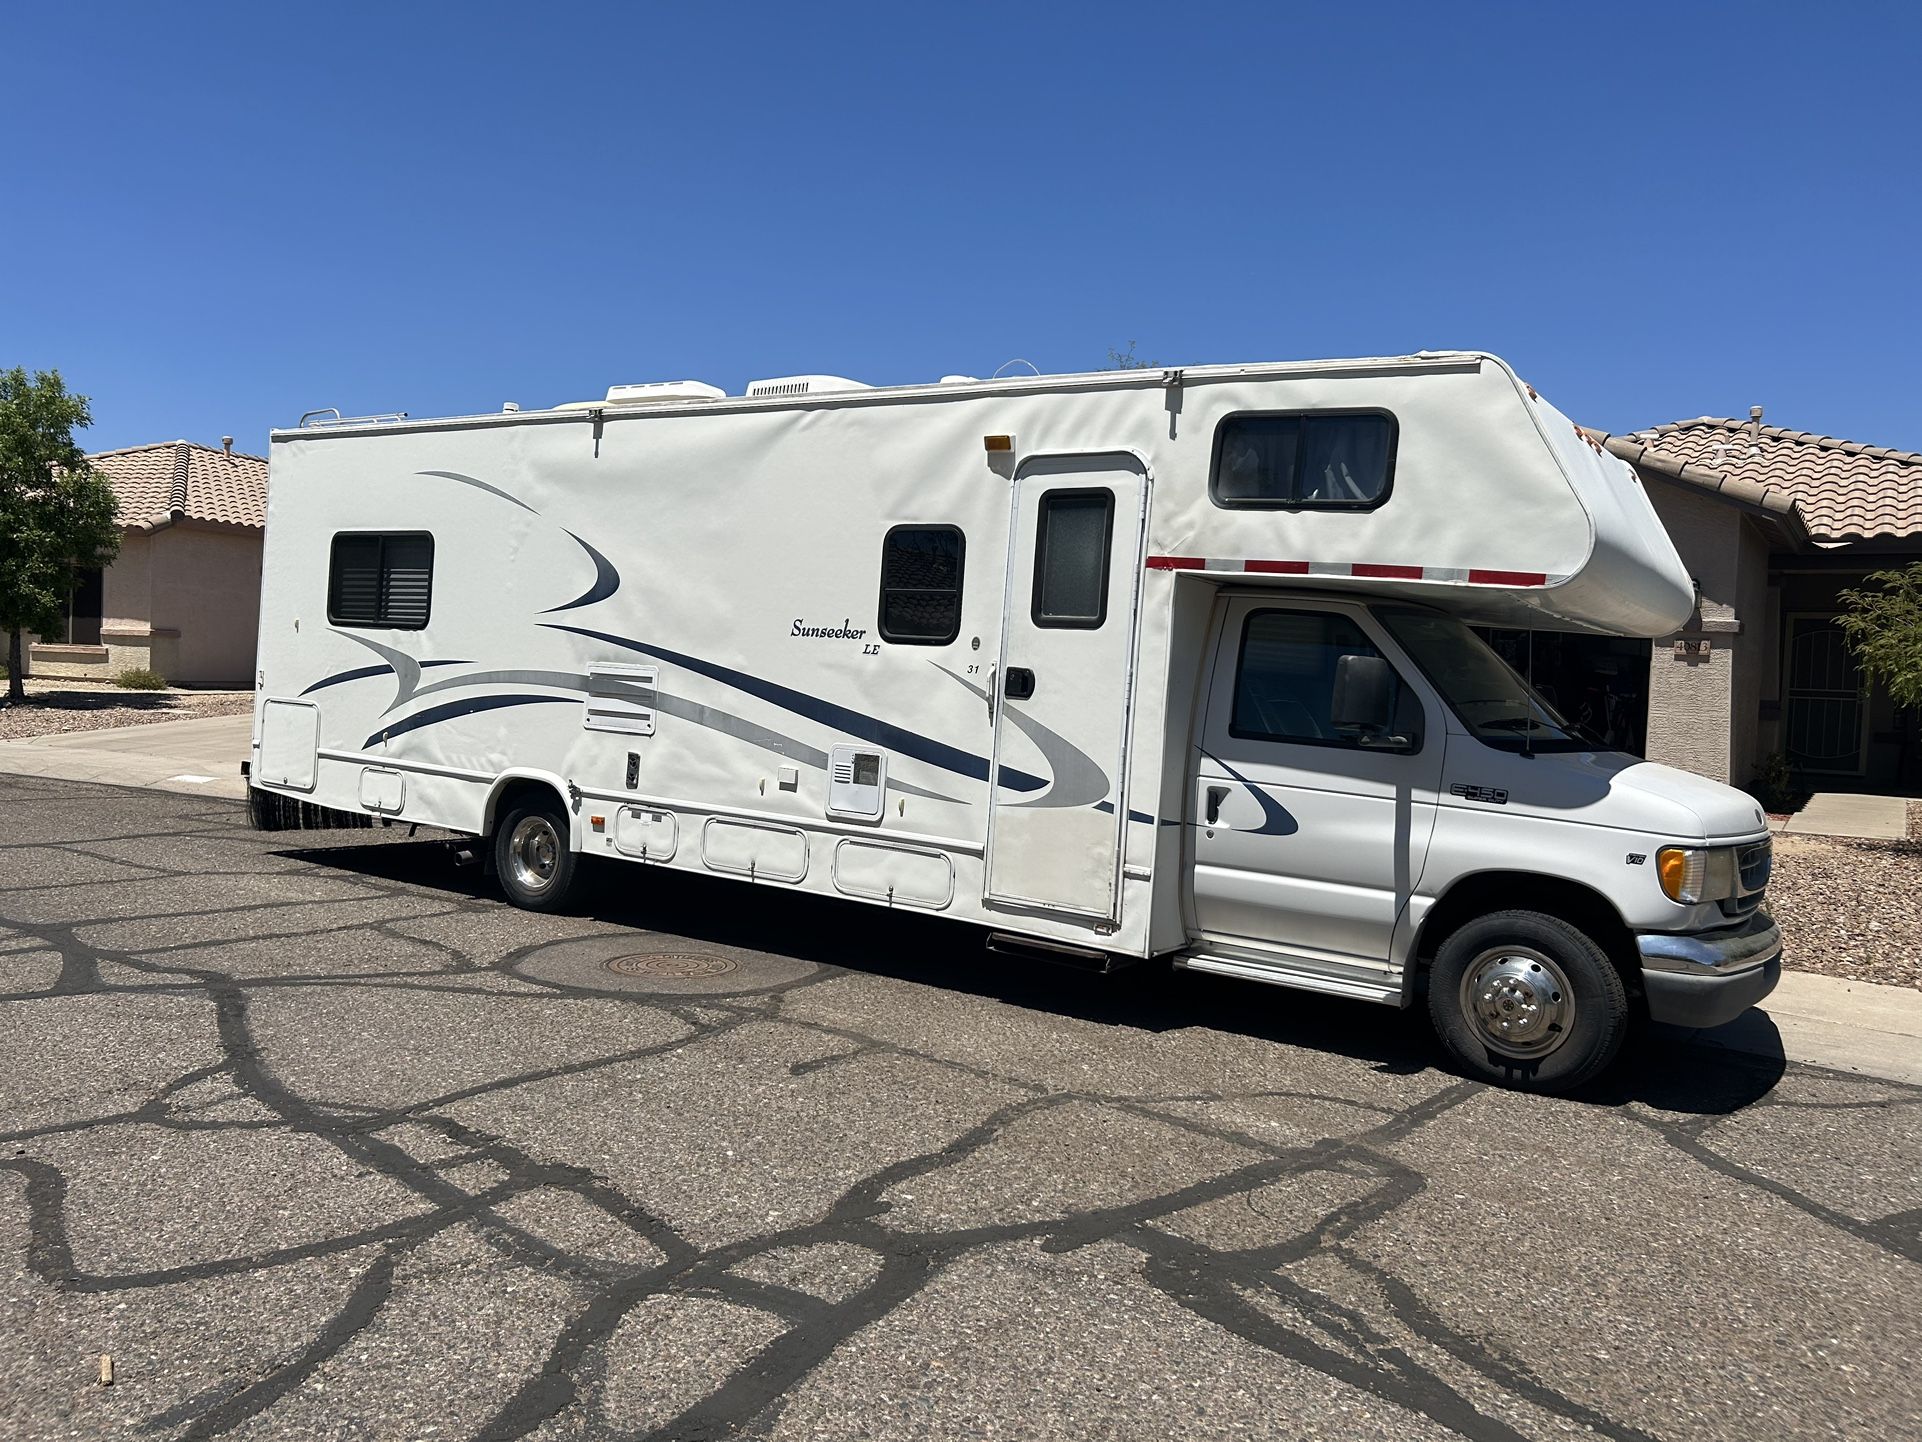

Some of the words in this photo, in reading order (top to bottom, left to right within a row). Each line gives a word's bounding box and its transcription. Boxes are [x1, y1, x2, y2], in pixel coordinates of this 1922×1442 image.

[790, 618, 867, 640] Sunseeker
[862, 644, 881, 655] LE
[967, 664, 980, 674] 31
[1627, 855, 1644, 864] V10
